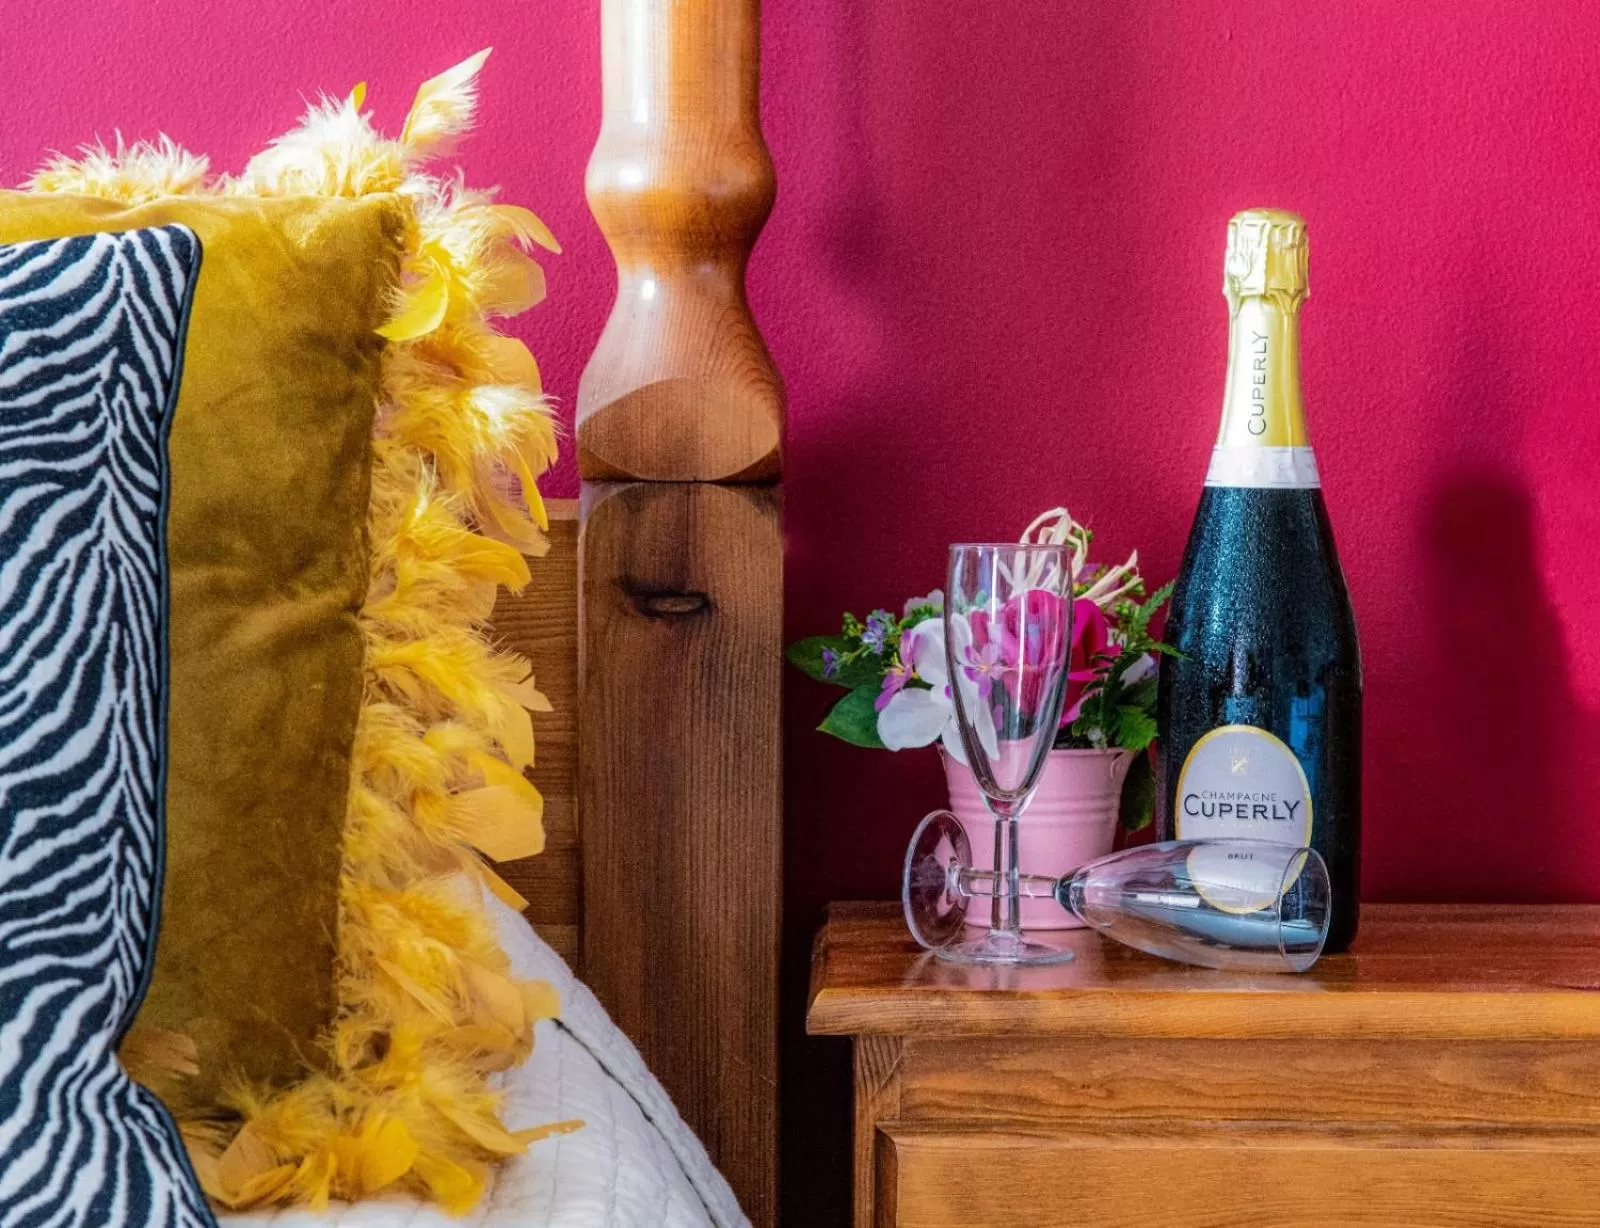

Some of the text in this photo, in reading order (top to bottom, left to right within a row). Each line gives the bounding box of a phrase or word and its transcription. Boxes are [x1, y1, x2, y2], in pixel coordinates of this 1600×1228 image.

[1248, 331, 1268, 435] CUPERLY
[1201, 790, 1277, 801] CHAMPAGNE
[1184, 794, 1300, 819] CUPERLY
[1227, 853, 1254, 861] BRUT
